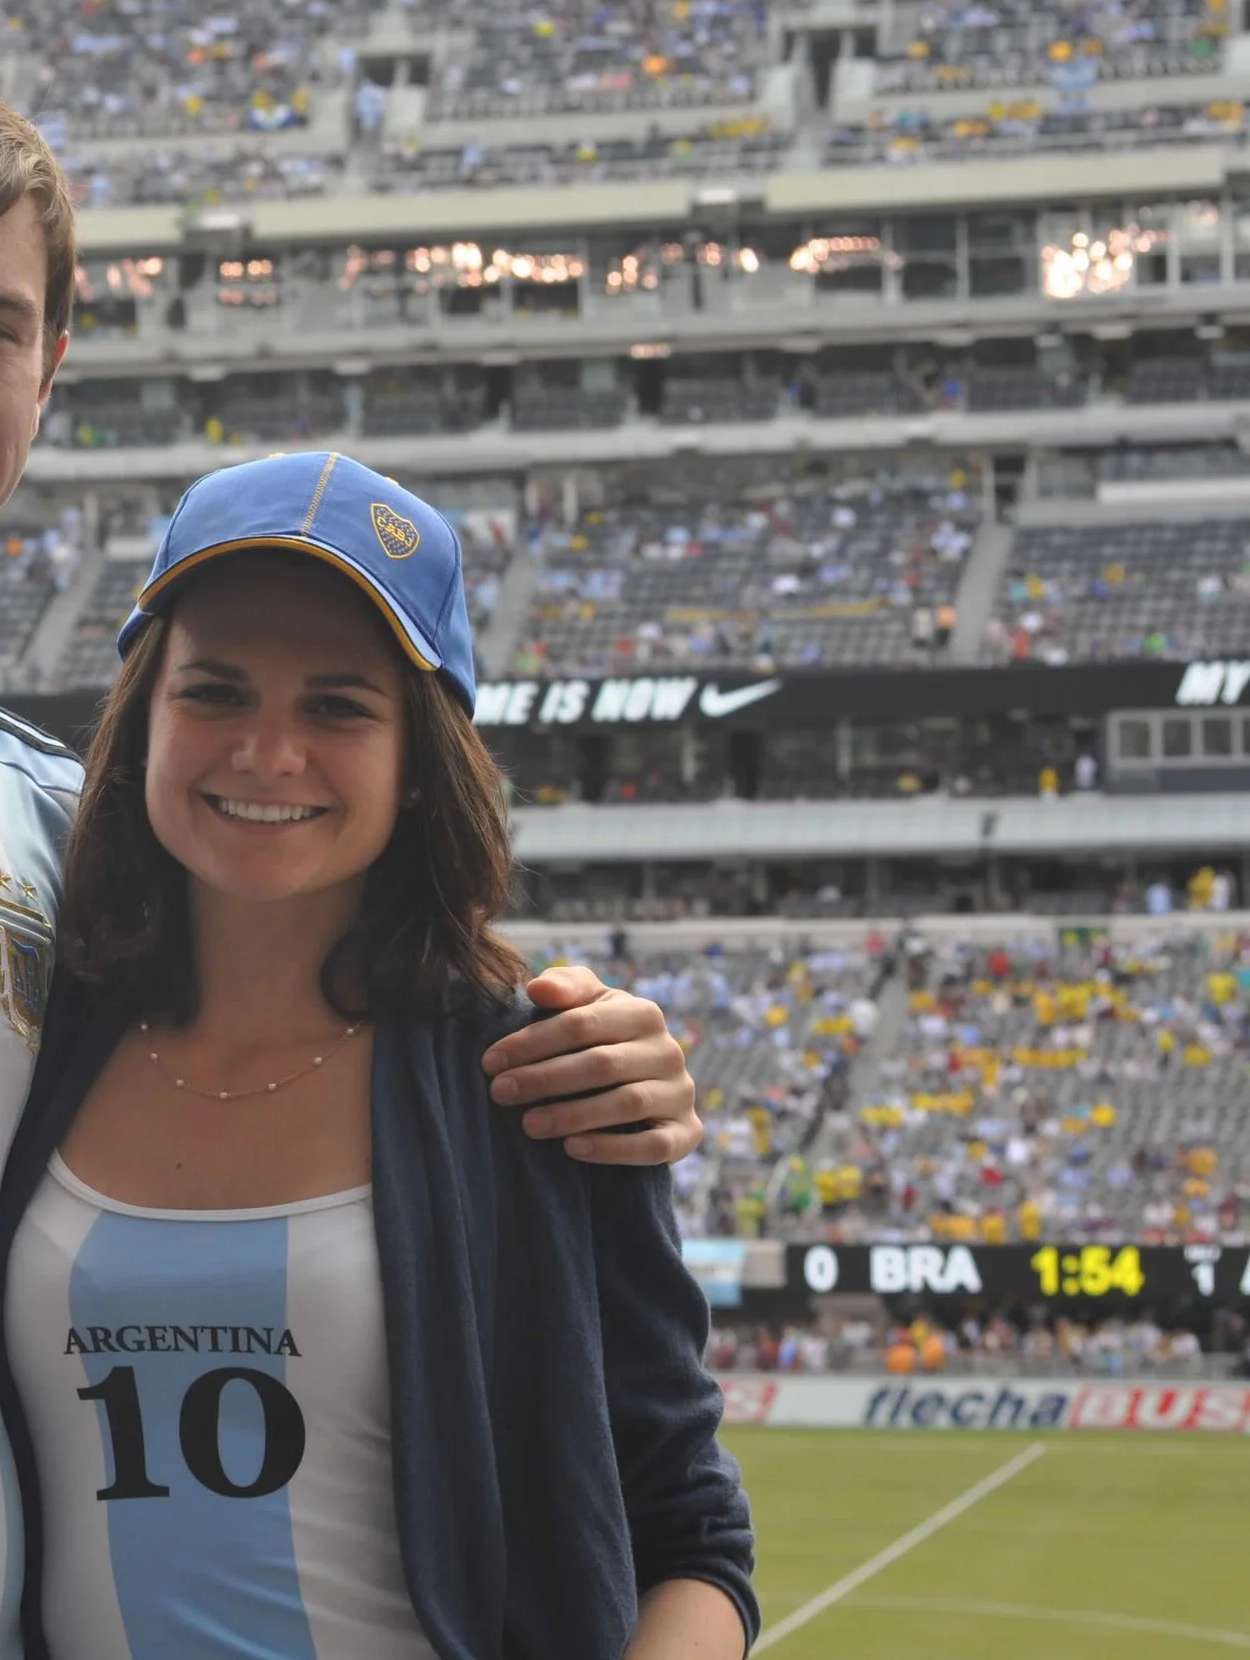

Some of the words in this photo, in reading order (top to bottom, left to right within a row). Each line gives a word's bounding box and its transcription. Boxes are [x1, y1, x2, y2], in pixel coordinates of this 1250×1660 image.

[472, 681, 540, 725] ME
[538, 679, 590, 724] IS
[591, 676, 698, 722] NOW
[1175, 660, 1250, 706] MY
[870, 1246, 983, 1294] BRA
[1031, 1246, 1145, 1296] 1:54
[63, 1325, 303, 1357] ARGENTINA
[76, 1366, 306, 1501] 10
